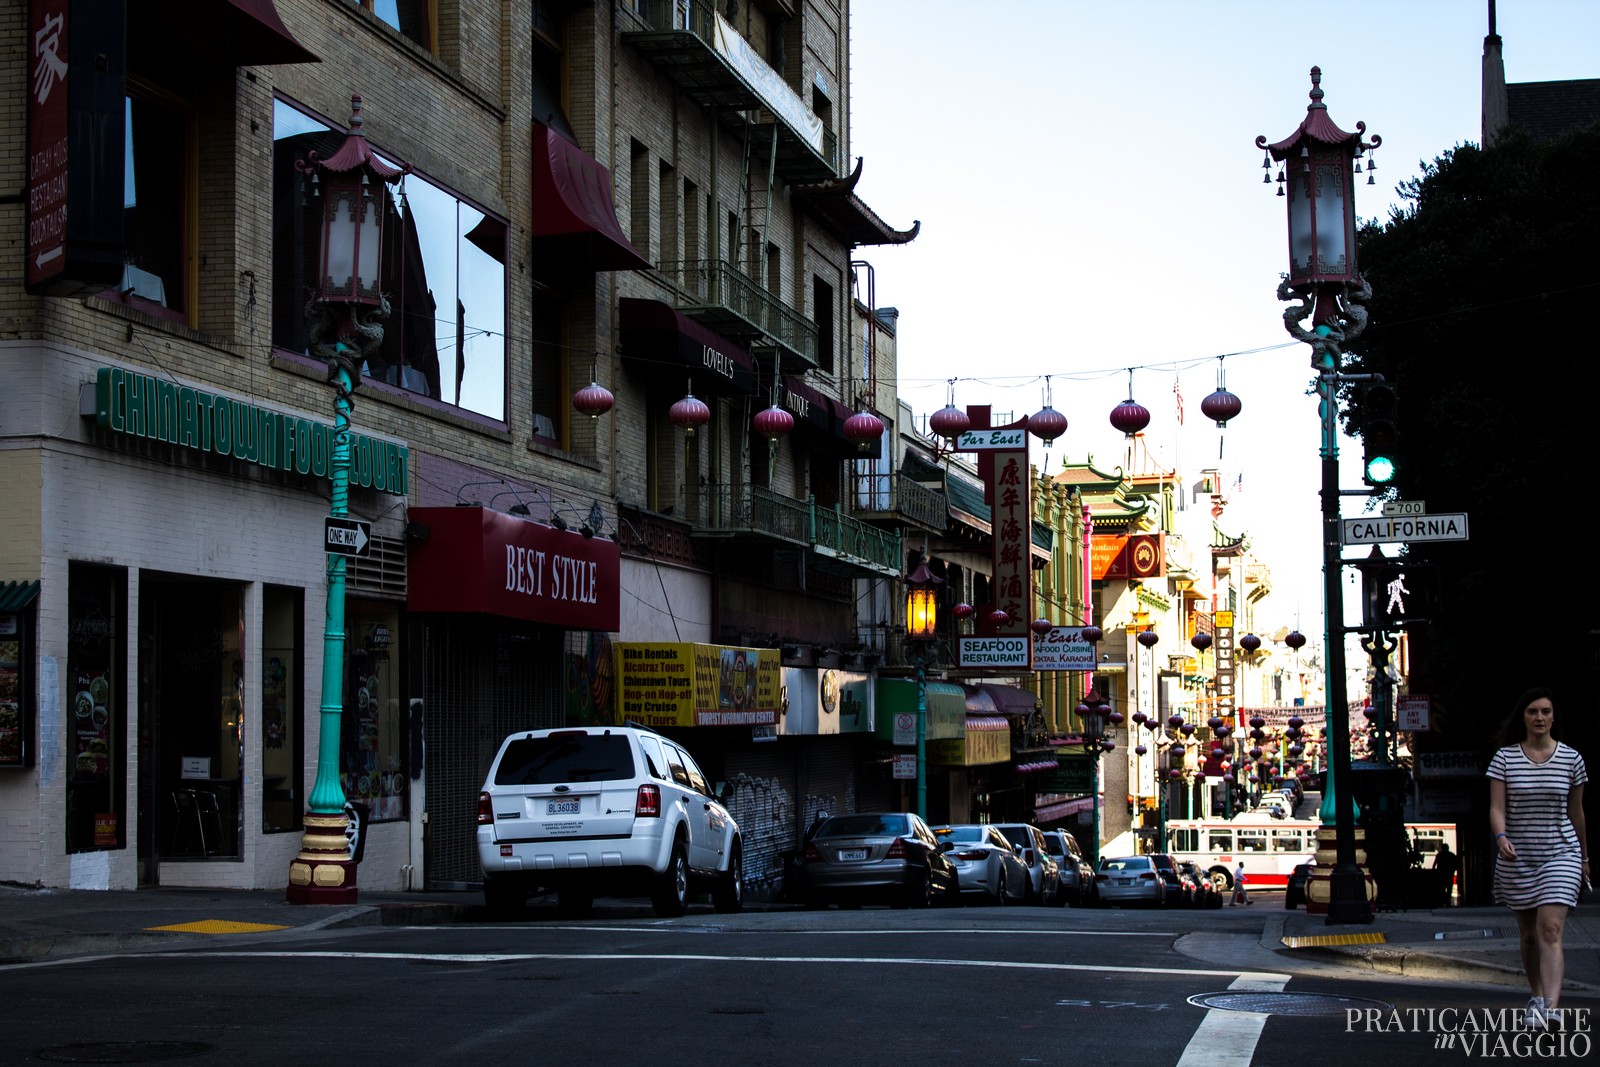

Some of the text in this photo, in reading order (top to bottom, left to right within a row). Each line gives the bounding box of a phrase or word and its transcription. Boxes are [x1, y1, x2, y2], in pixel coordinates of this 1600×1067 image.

[34, 11, 69, 105] 家
[30, 207, 61, 247] COCKTAILS
[703, 345, 734, 379] LOVELL'S
[111, 366, 276, 468] CHINATOWN
[961, 431, 1021, 446] Far East
[1398, 504, 1421, 513] 700
[1353, 519, 1458, 539] CALIFORNIA
[328, 530, 358, 544] ONE WAY
[505, 544, 597, 604] BEST STYLE
[1048, 629, 1078, 643] East
[964, 641, 1024, 652] SEAFOOD
[1033, 645, 1060, 653] EAFOOD
[1219, 628, 1231, 669] FOUR
[624, 649, 678, 659] Bike Rentals
[962, 653, 1026, 663] RESTAURANT
[1034, 655, 1057, 663] CKTAIL
[624, 662, 685, 673] Alcatraz Tours
[624, 676, 691, 687] Chinatown Tours
[624, 690, 692, 700] Hop-on Hop-off
[624, 702, 677, 712] Bay Cruise
[1406, 702, 1428, 710] STOPPING
[646, 714, 677, 725] Tours
[698, 711, 775, 726] TOURIST INFORMATION CENTER
[1422, 753, 1482, 768] BAZAAR
